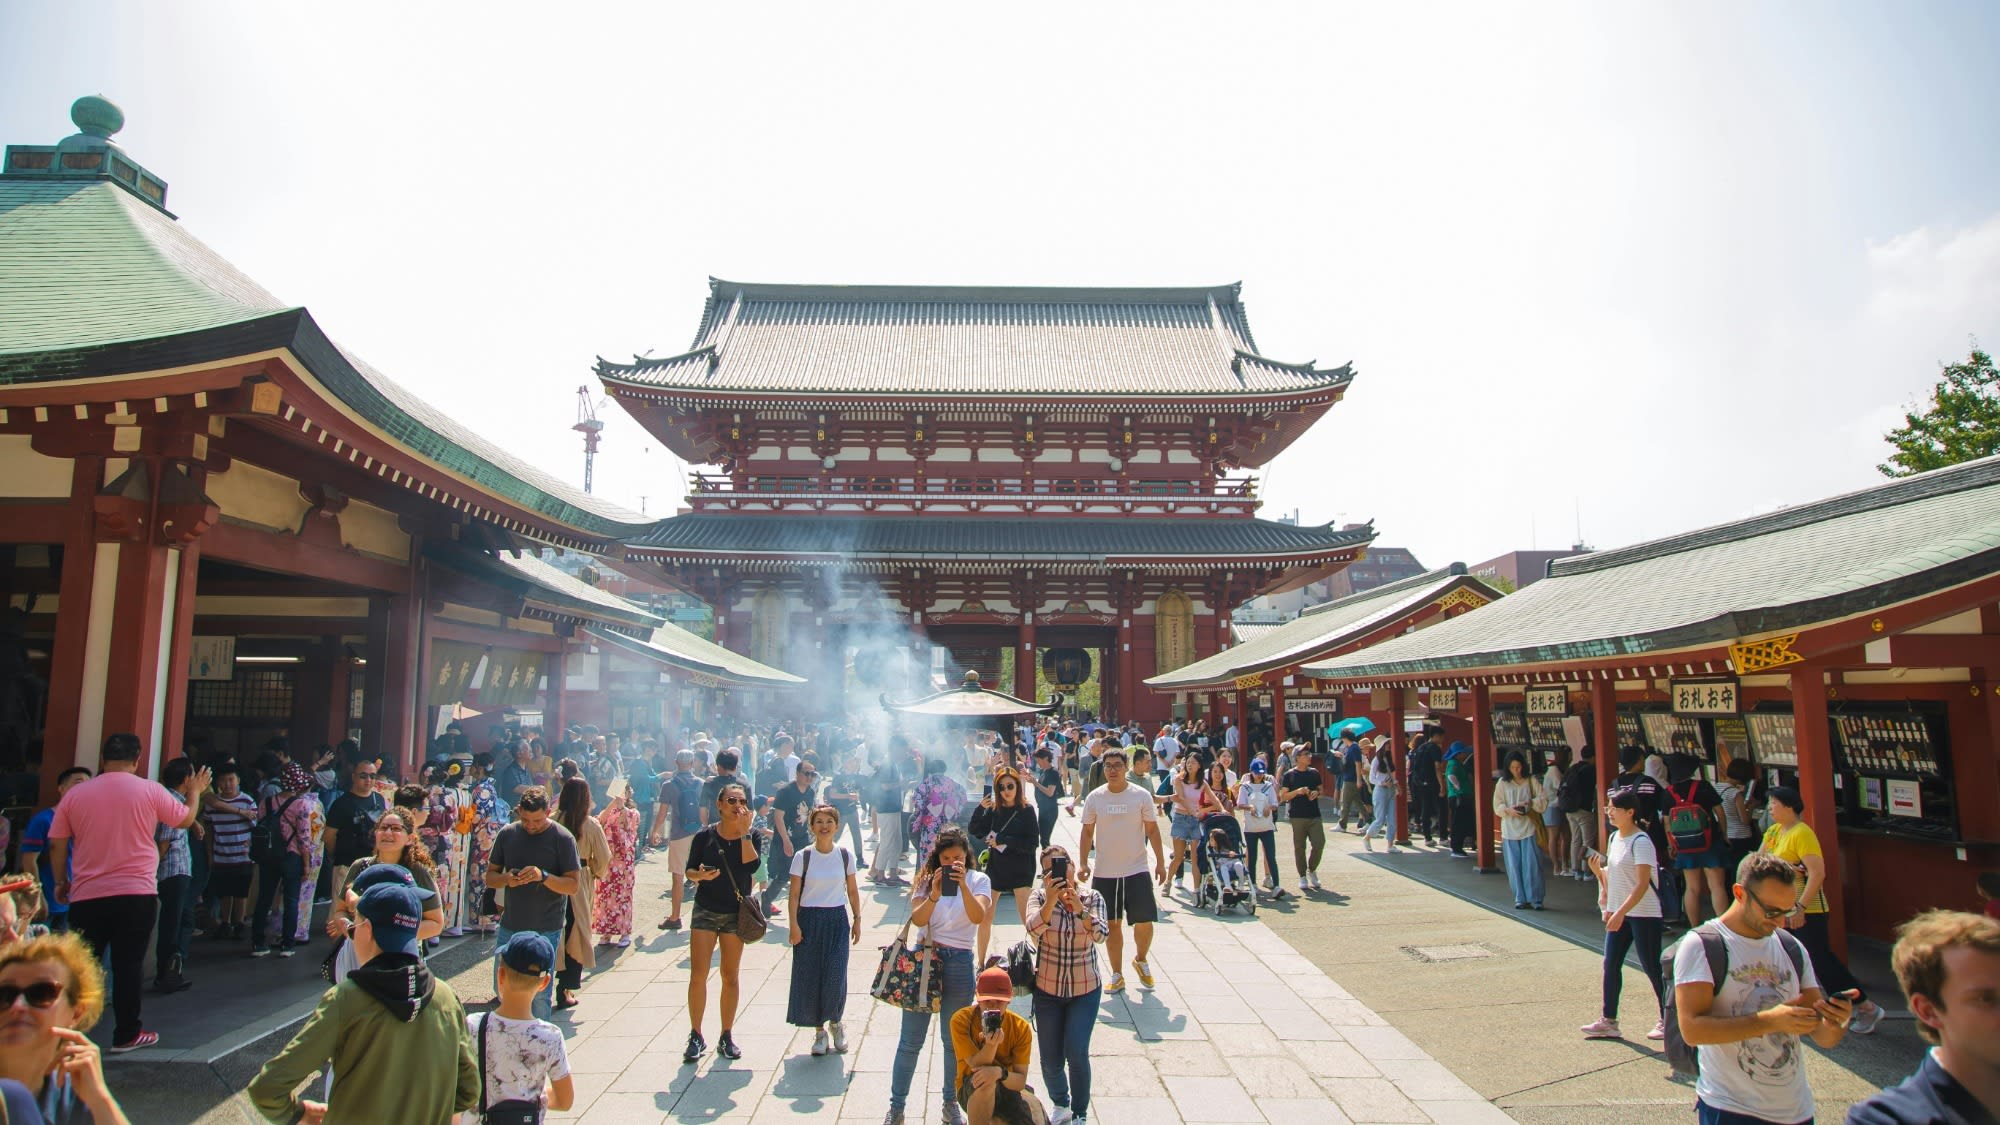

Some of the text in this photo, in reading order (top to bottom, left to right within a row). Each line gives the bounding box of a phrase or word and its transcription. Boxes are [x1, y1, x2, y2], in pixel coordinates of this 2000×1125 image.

[1287, 701, 1334, 710] 古札お納め所
[1530, 694, 1565, 711] お札お守
[1679, 686, 1734, 710] お札お守
